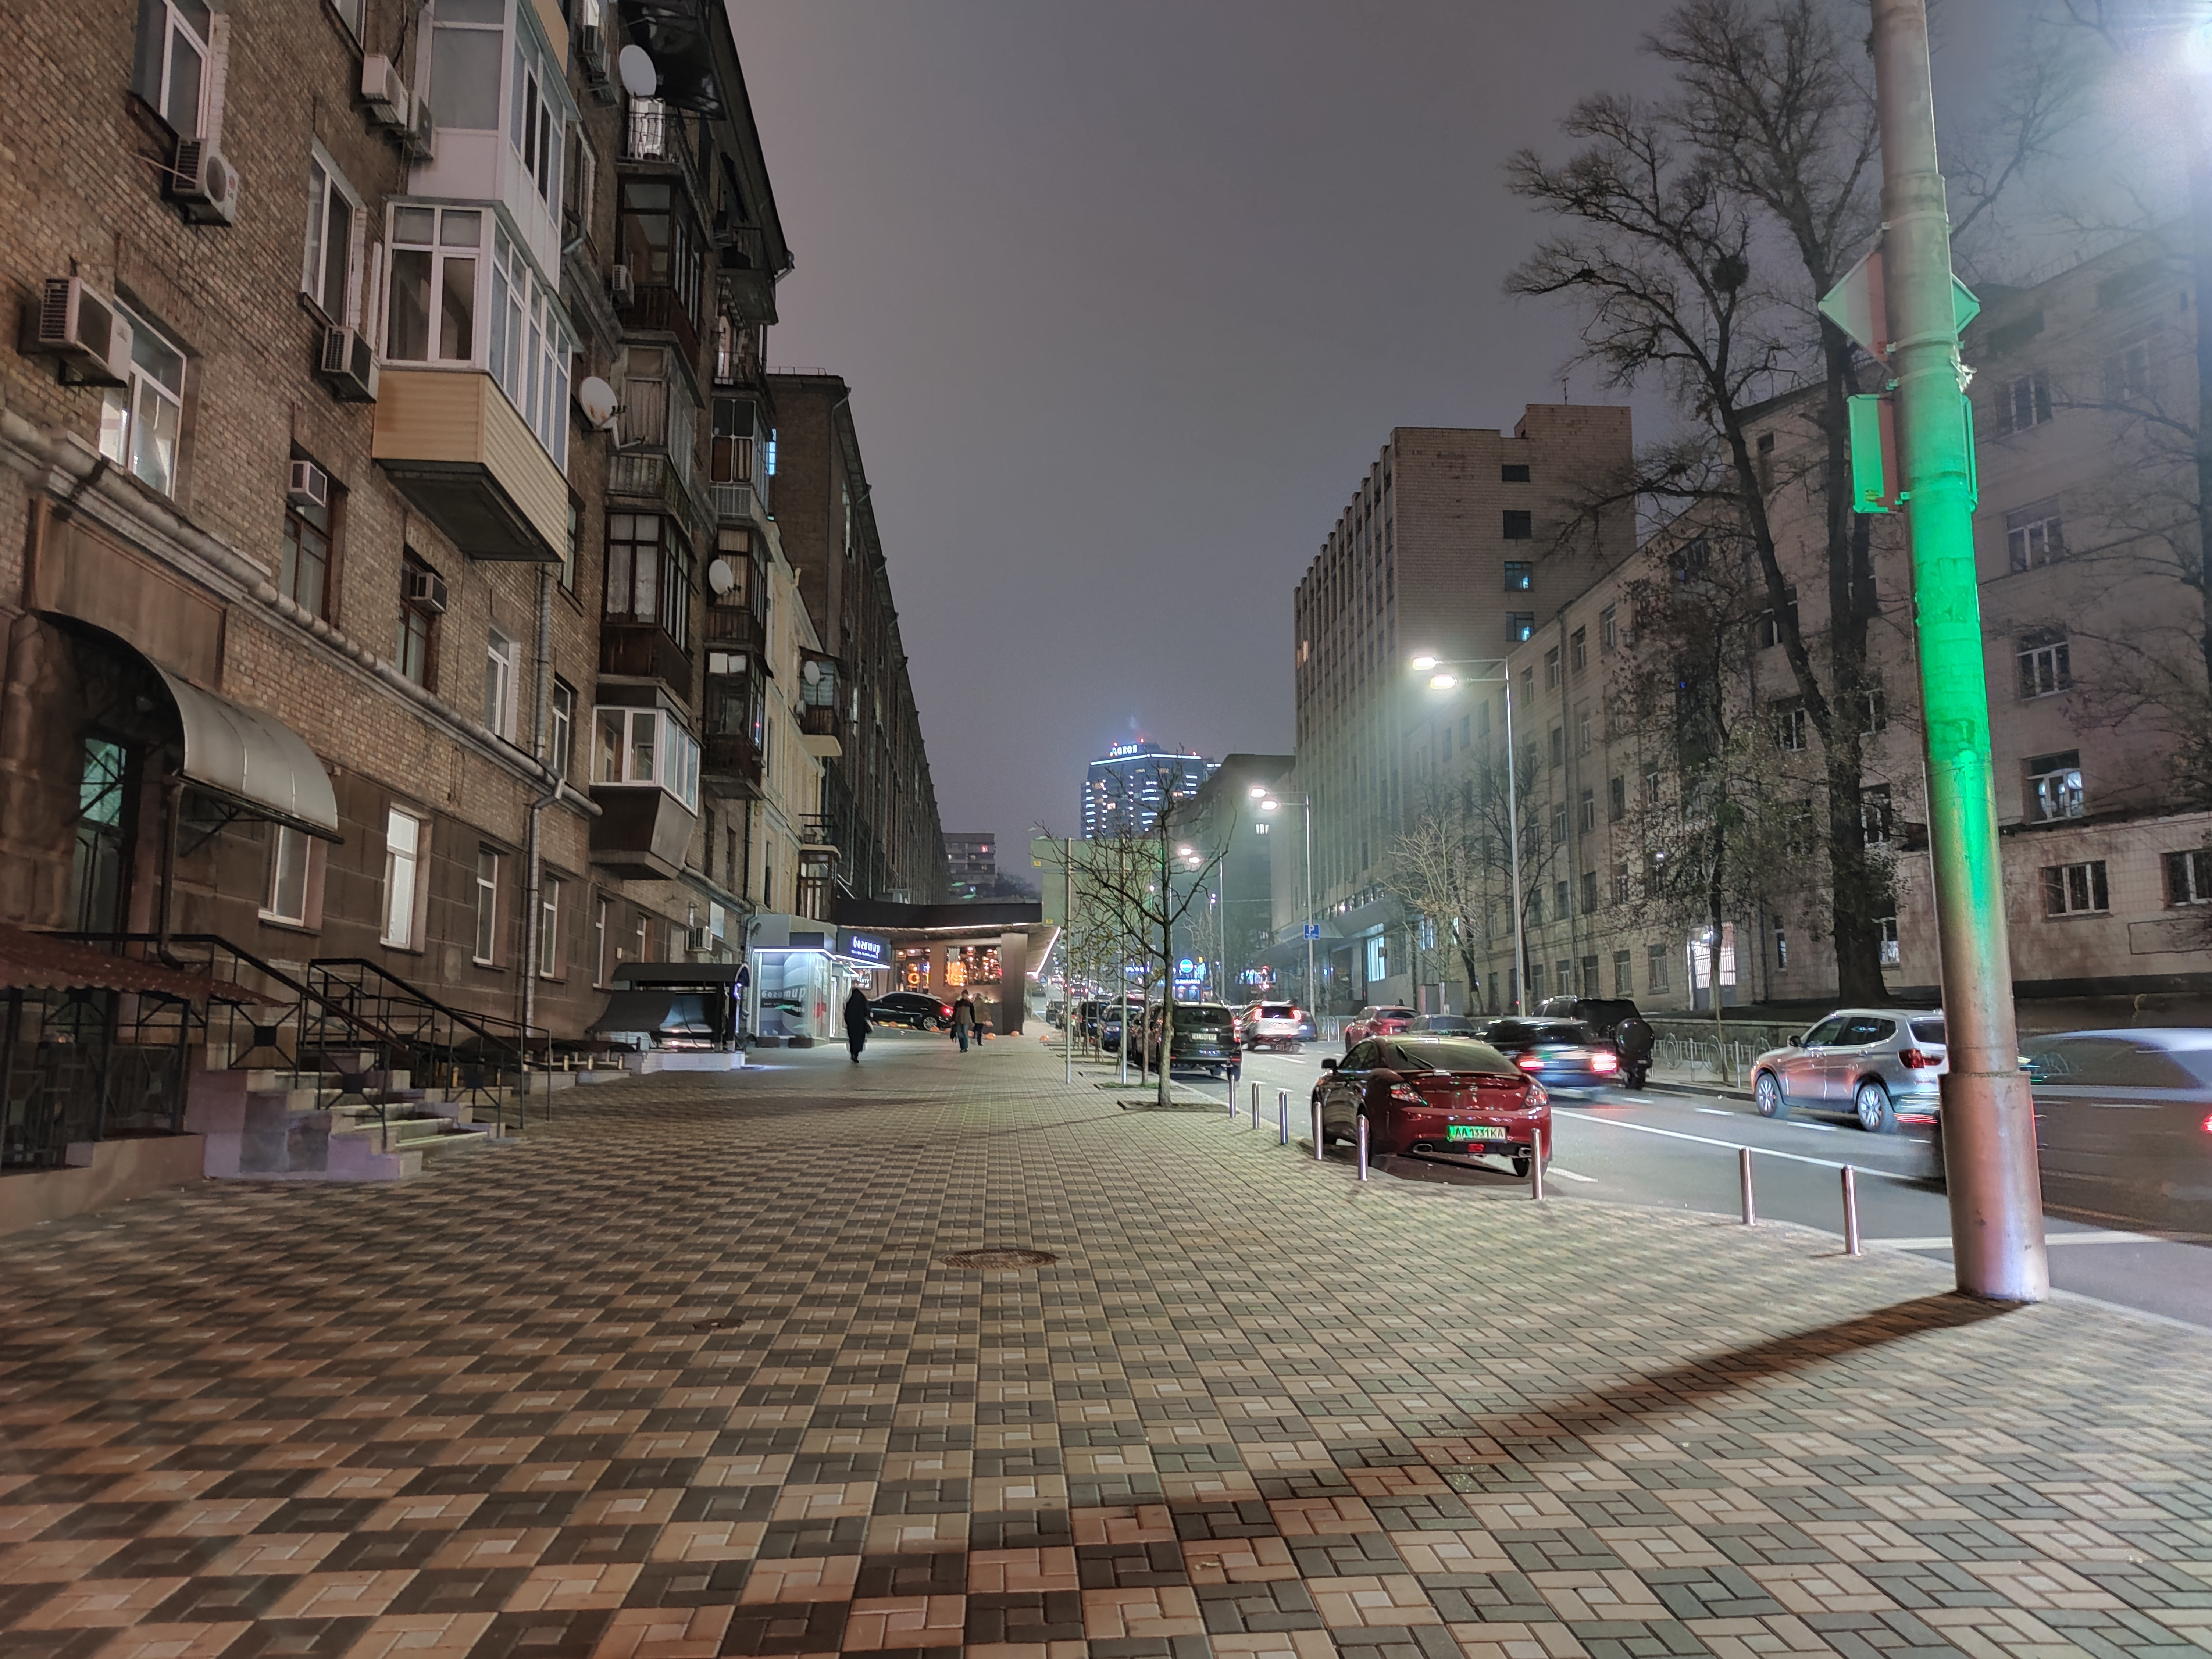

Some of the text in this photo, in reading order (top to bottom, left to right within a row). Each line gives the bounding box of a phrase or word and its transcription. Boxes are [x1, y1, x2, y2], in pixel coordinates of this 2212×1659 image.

[1309, 925, 1315, 934] P
[853, 936, 880, 959] богатир
[761, 987, 806, 1002] богатир
